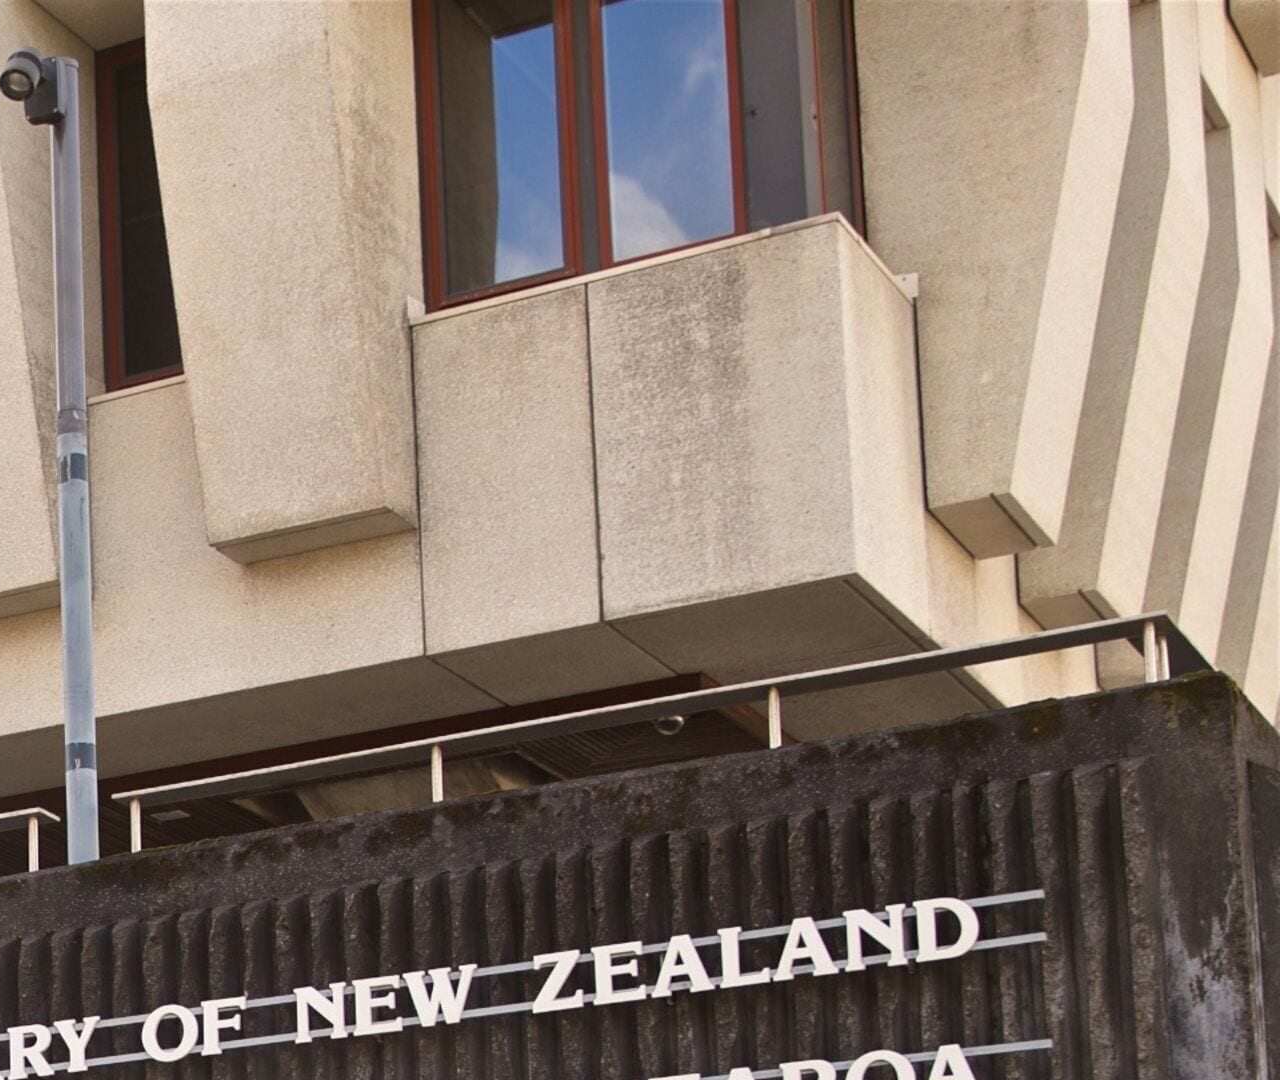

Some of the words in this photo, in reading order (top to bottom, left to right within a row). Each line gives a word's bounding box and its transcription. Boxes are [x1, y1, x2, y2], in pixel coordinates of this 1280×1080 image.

[141, 996, 246, 1063] OF
[293, 964, 477, 1044] NEW
[533, 896, 980, 1013] ZEALAND
